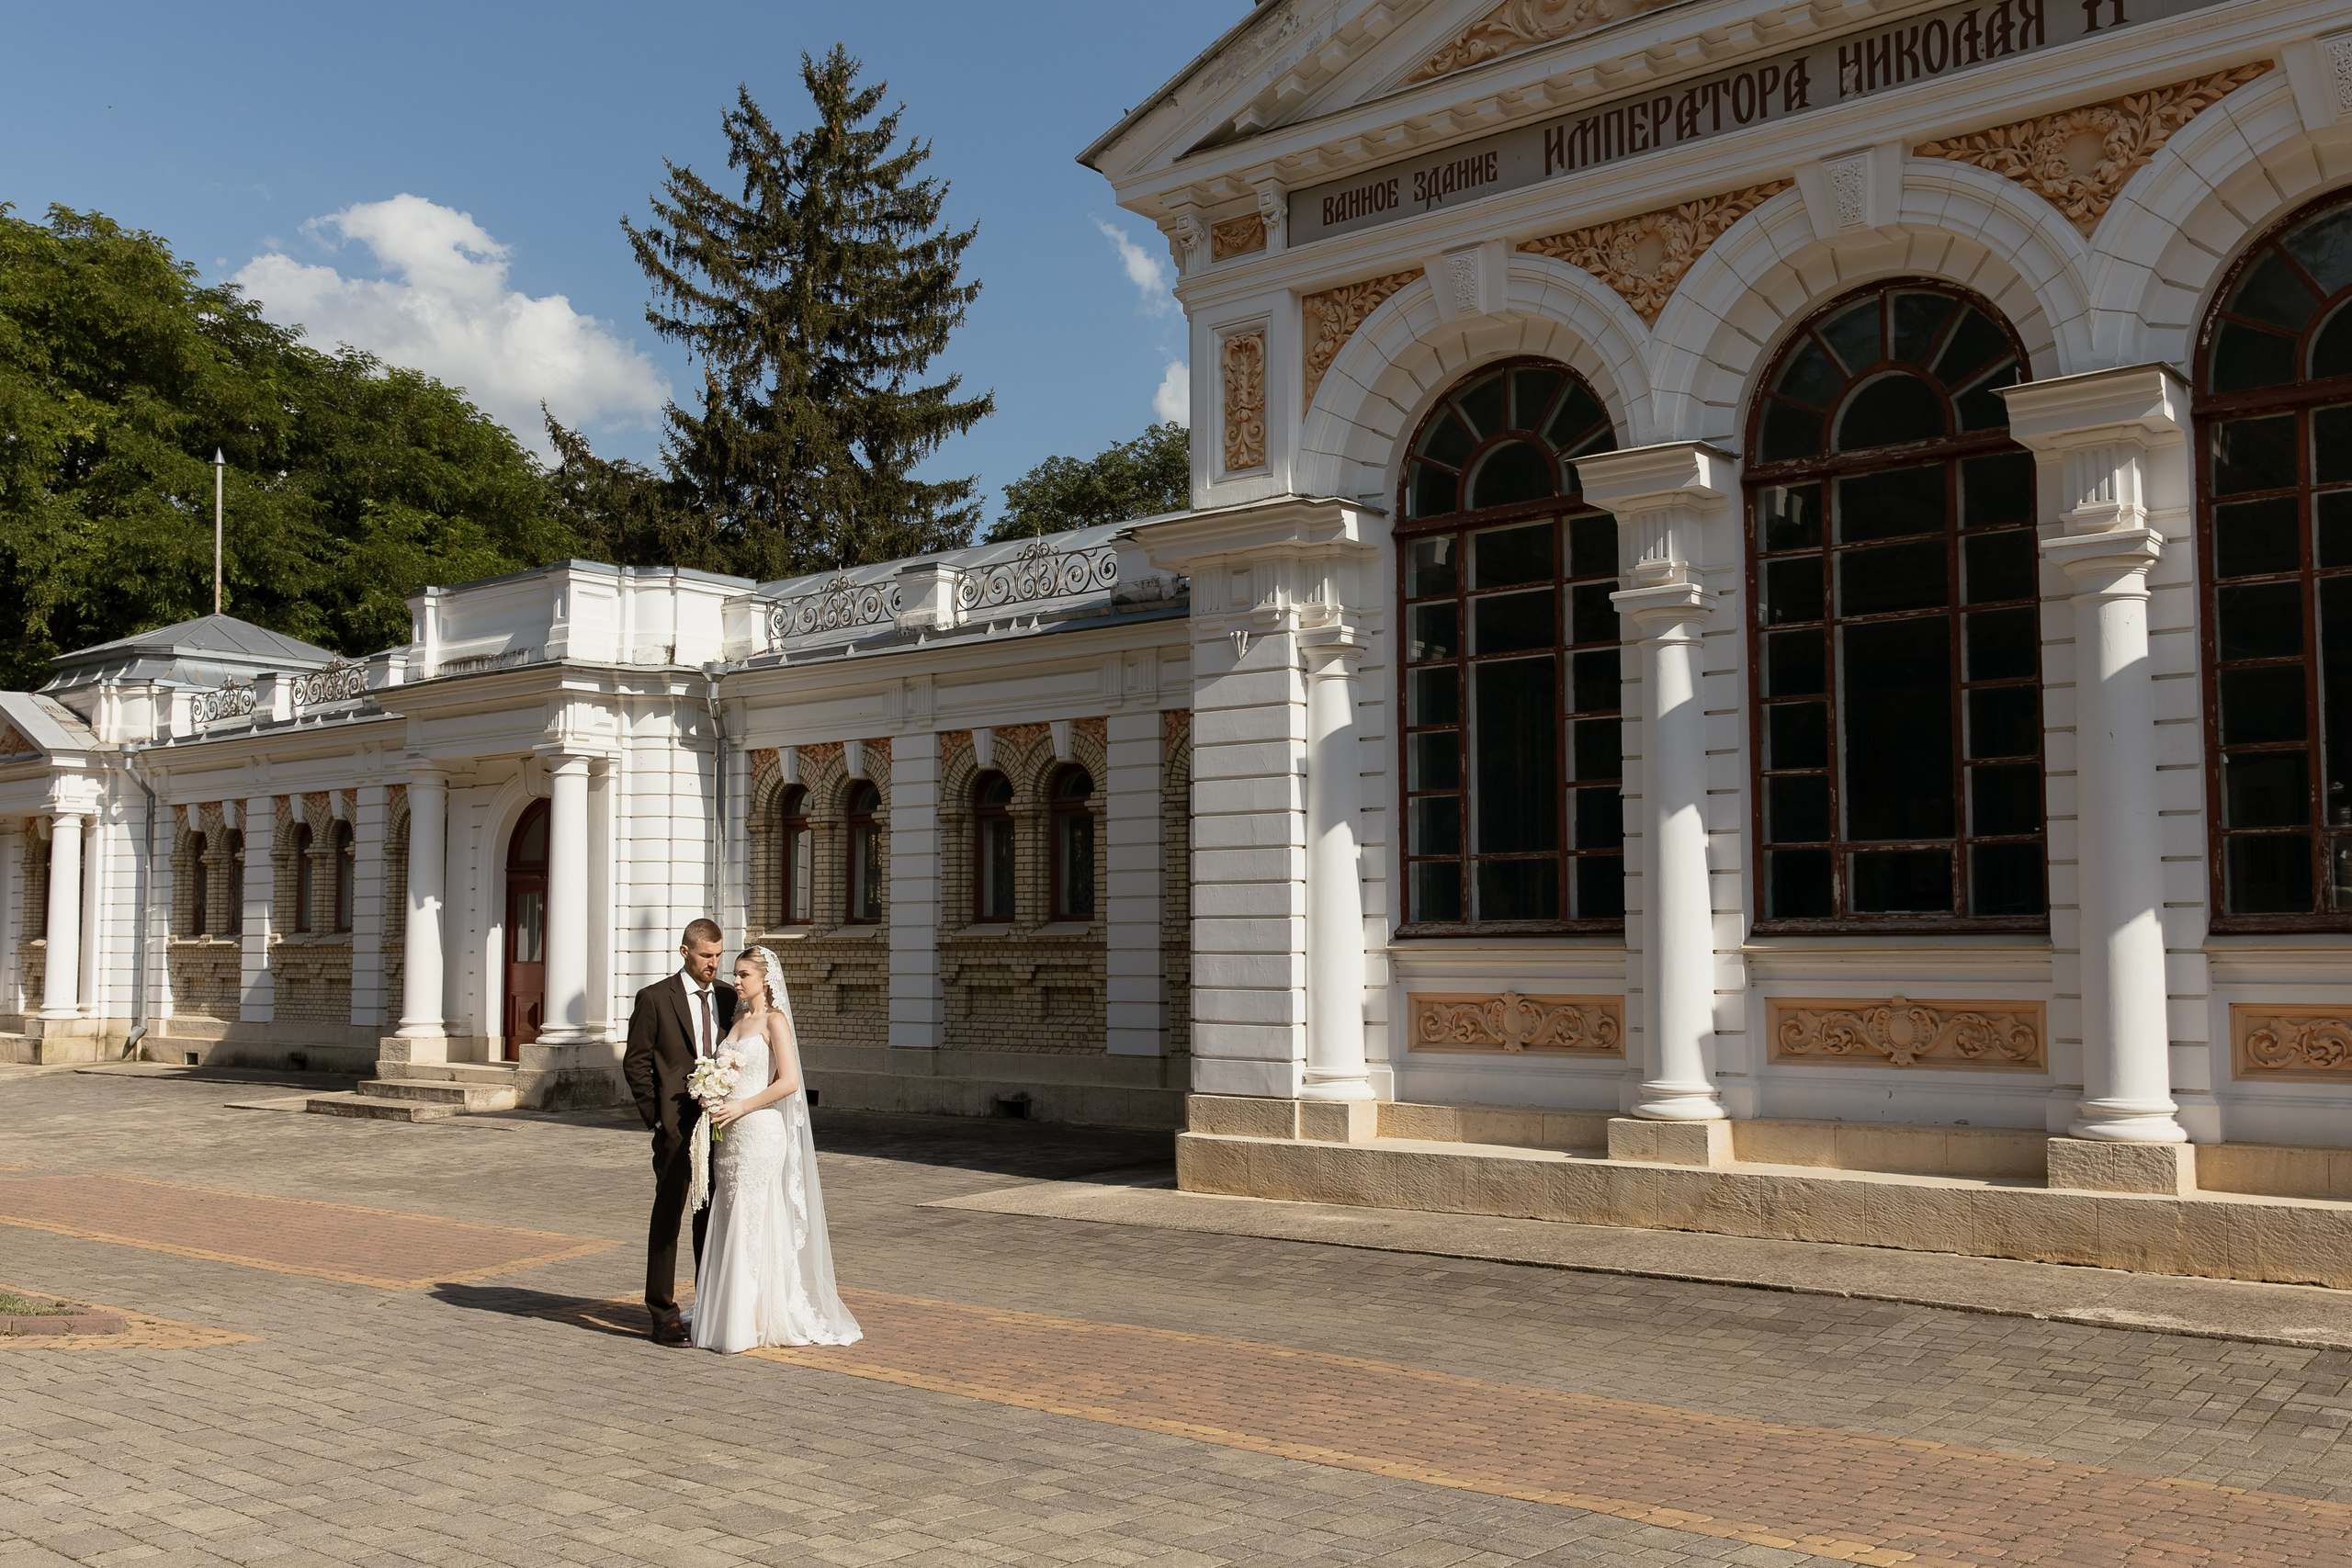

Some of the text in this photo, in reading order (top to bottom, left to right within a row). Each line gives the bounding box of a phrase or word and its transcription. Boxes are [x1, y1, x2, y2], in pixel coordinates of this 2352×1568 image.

[1323, 178, 1398, 226] ВАННОЕ
[1414, 151, 1498, 211] ЗДАНИЕ
[1544, 55, 1812, 176] ИМПЕРАТОРА
[1838, 0, 2045, 98] НИКОЛАЯ
